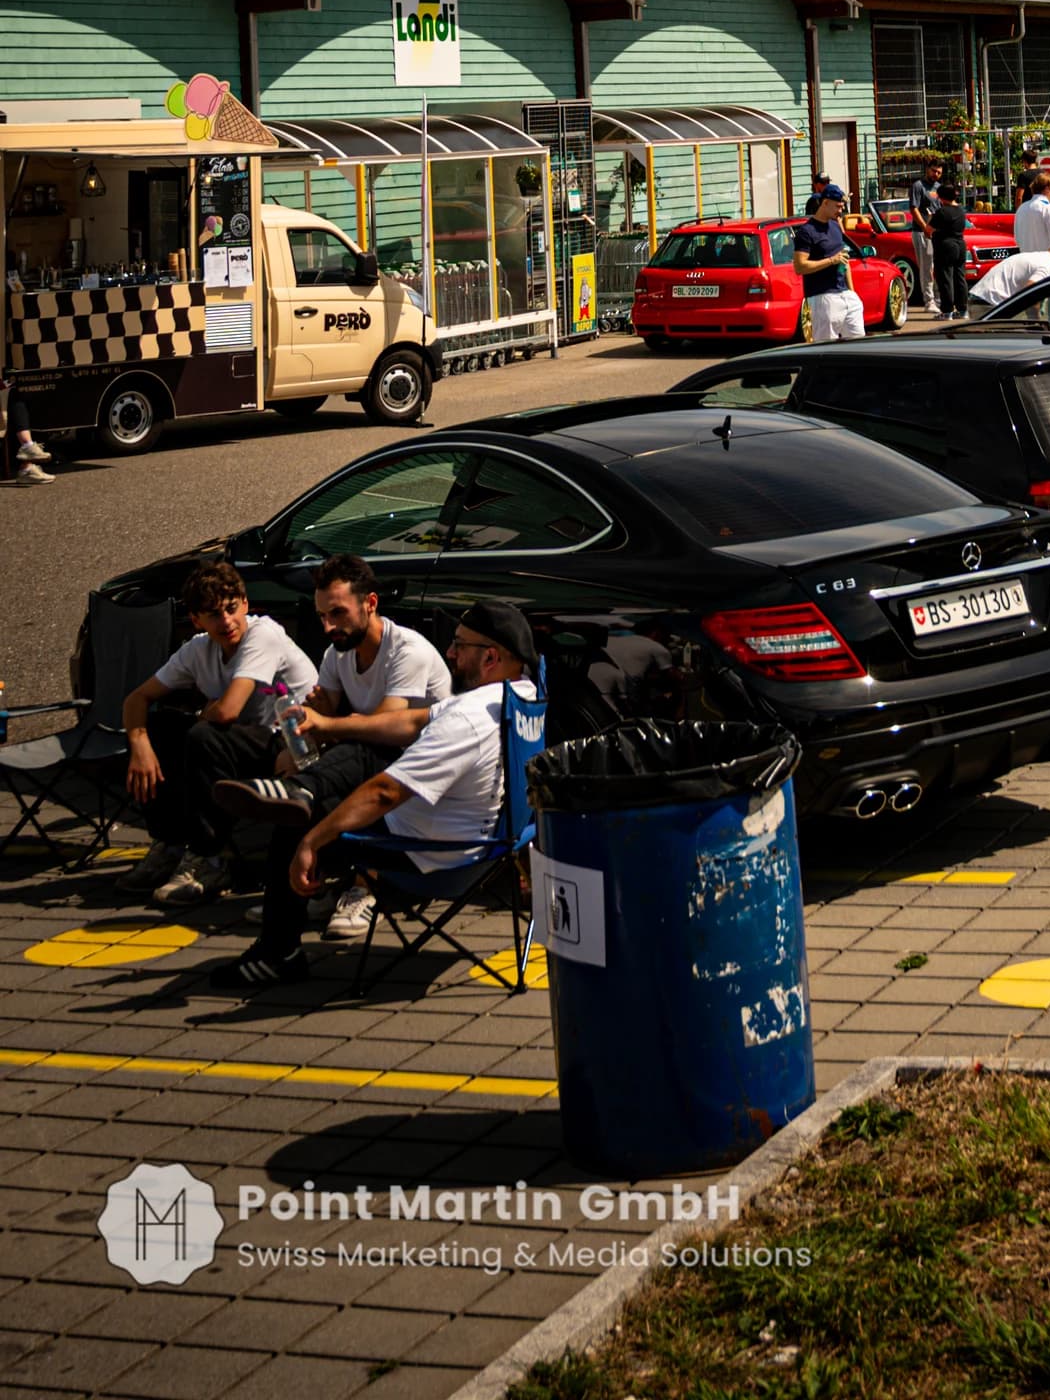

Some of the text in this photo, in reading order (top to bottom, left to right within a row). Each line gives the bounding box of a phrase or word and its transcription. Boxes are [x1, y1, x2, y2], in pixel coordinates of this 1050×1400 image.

[396, 2, 456, 42] Landi
[816, 577, 856, 594] C 63
